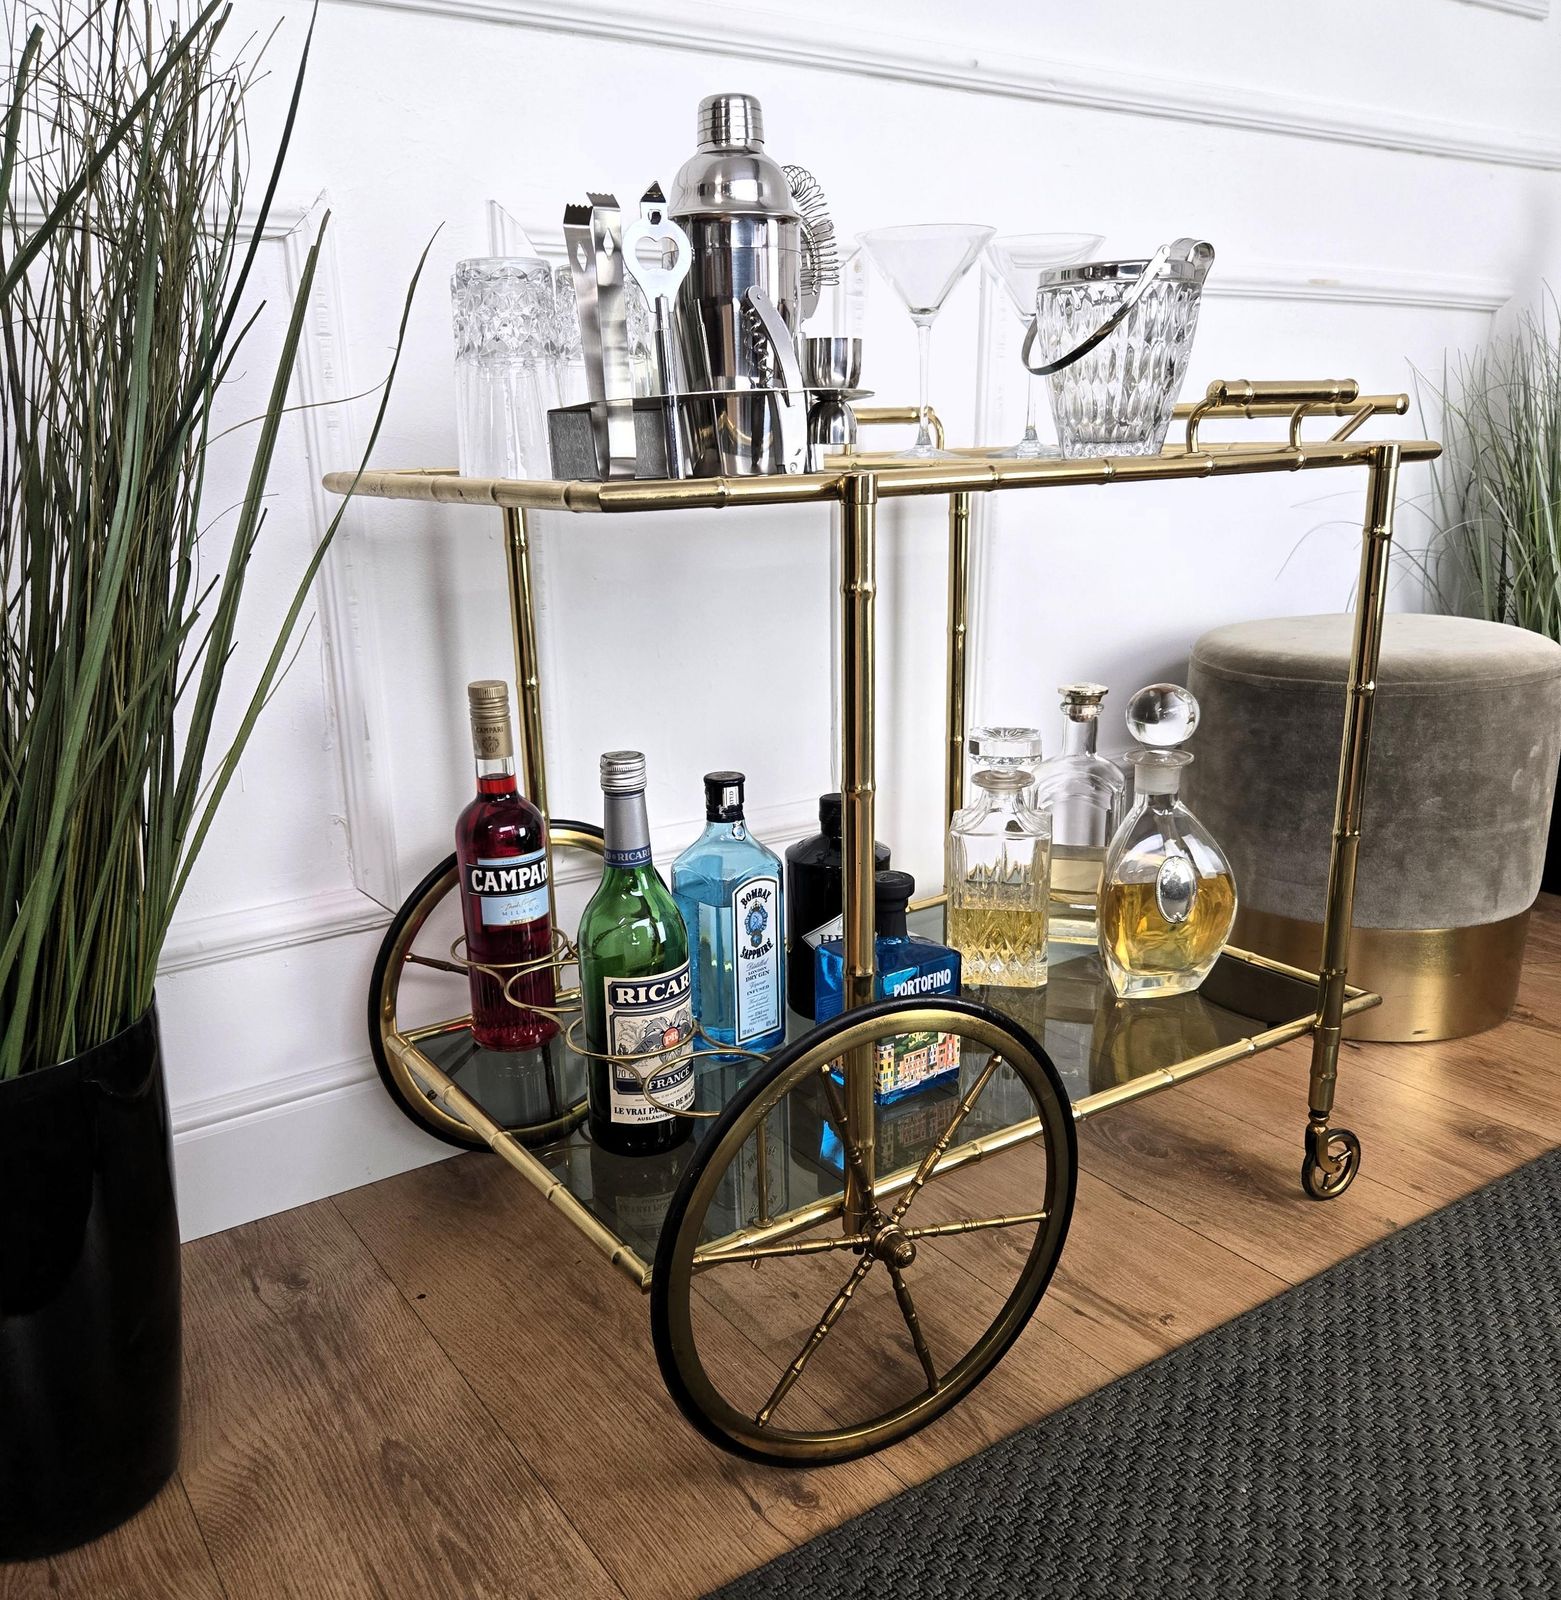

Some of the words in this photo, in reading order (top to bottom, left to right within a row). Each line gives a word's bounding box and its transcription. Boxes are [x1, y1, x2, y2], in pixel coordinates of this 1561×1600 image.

[476, 725, 504, 734] CAMPARI
[617, 848, 651, 862] RICAR
[471, 859, 549, 892] CAMPAR
[740, 887, 772, 909] BOMBAY
[502, 905, 540, 916] MILANO
[740, 937, 774, 960] SAPPHIRE
[745, 973, 758, 983] DRY
[748, 966, 768, 976] LONDON
[616, 967, 691, 1004] RICAR
[746, 984, 770, 996] INFUSED
[894, 968, 952, 998] PORTOFINO
[648, 1065, 691, 1090] FRANCE
[614, 1106, 625, 1115] LE
[626, 1107, 648, 1116] VRAI
